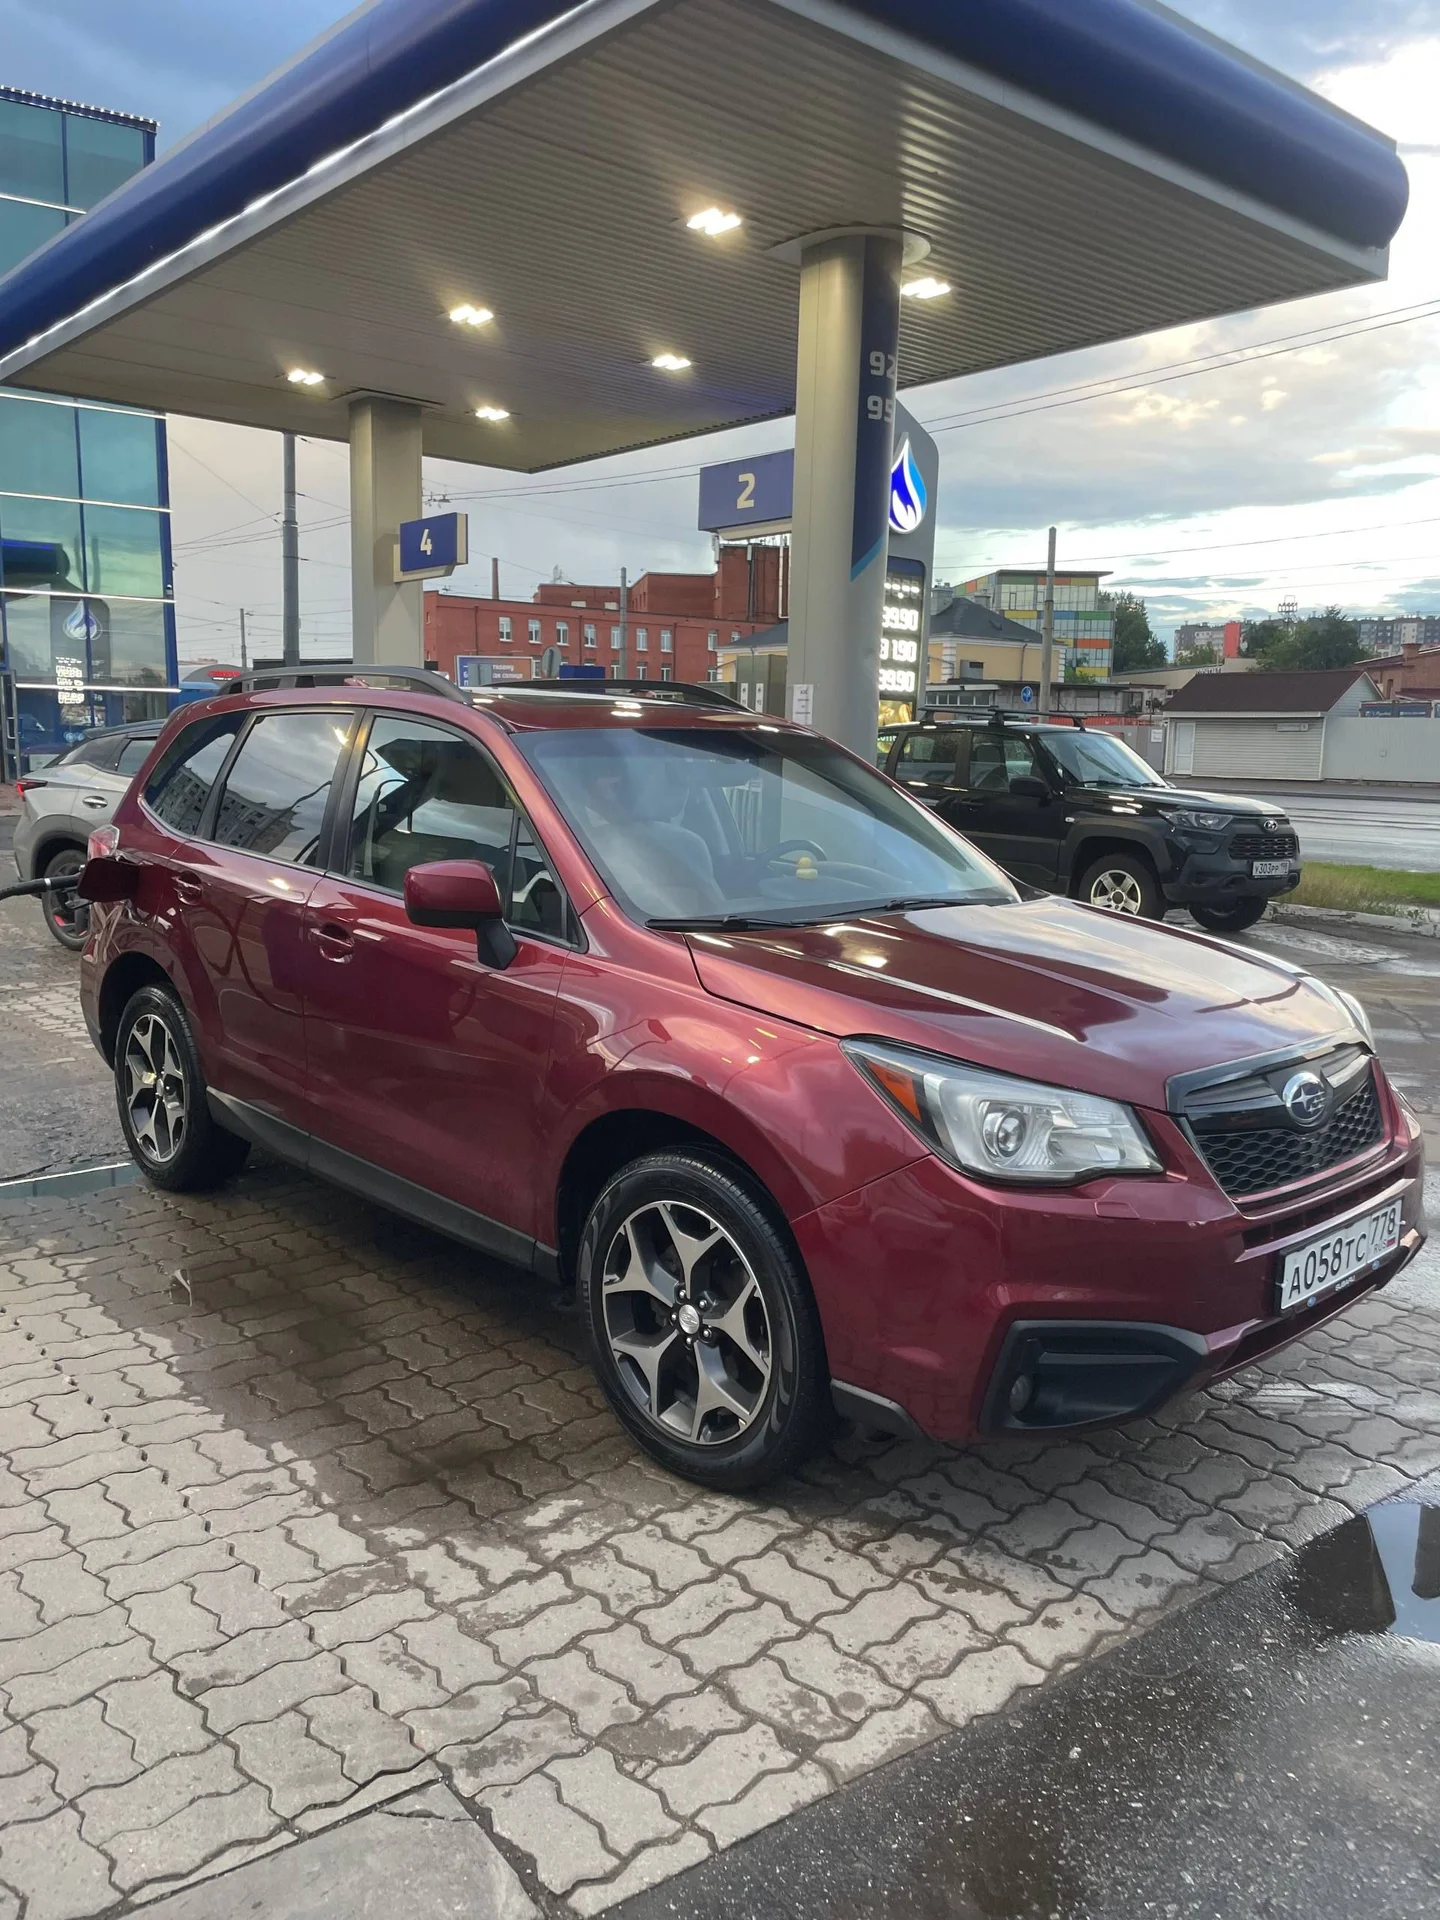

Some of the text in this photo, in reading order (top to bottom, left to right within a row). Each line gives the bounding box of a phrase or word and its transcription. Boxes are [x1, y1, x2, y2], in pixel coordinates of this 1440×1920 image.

[869, 351, 897, 380] 92
[736, 472, 756, 510] 2
[420, 528, 432, 556] 4
[1371, 1207, 1396, 1245] 778
